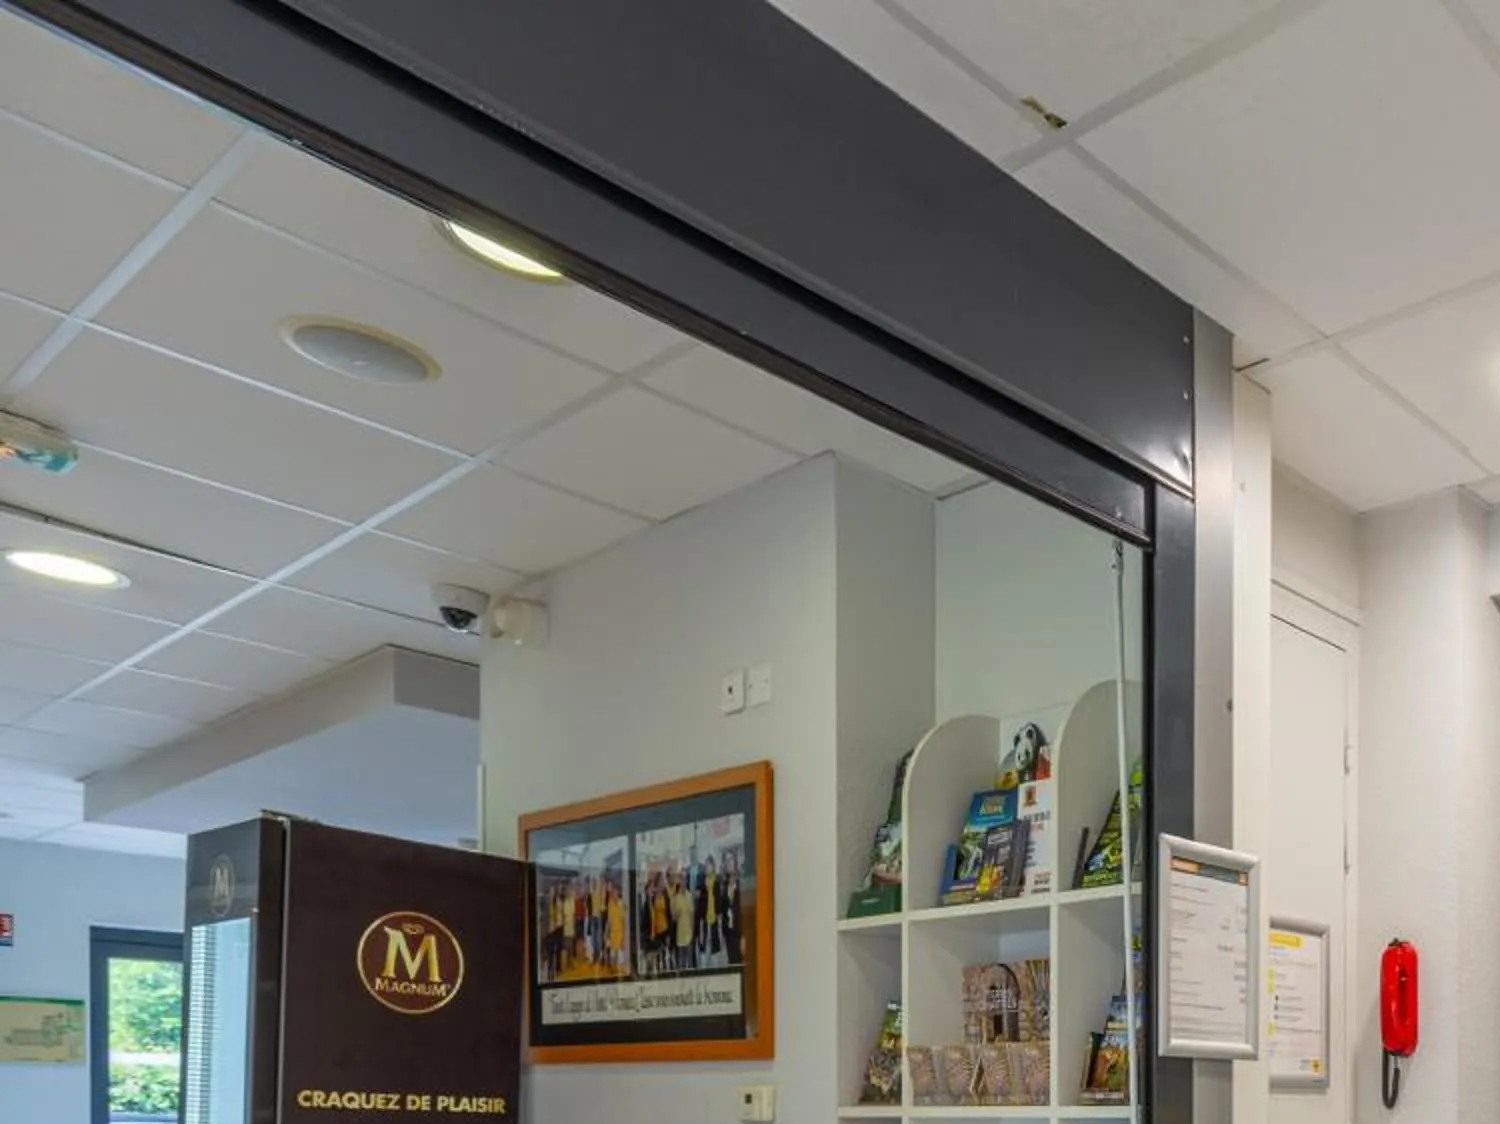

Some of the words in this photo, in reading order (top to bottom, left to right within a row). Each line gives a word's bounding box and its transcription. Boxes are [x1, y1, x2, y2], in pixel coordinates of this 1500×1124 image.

[381, 925, 442, 982] M
[374, 977, 447, 998] MAGNUM
[297, 1089, 400, 1111] CRAQUEZ
[405, 1094, 431, 1112] DE
[436, 1096, 506, 1115] PLAISIR
